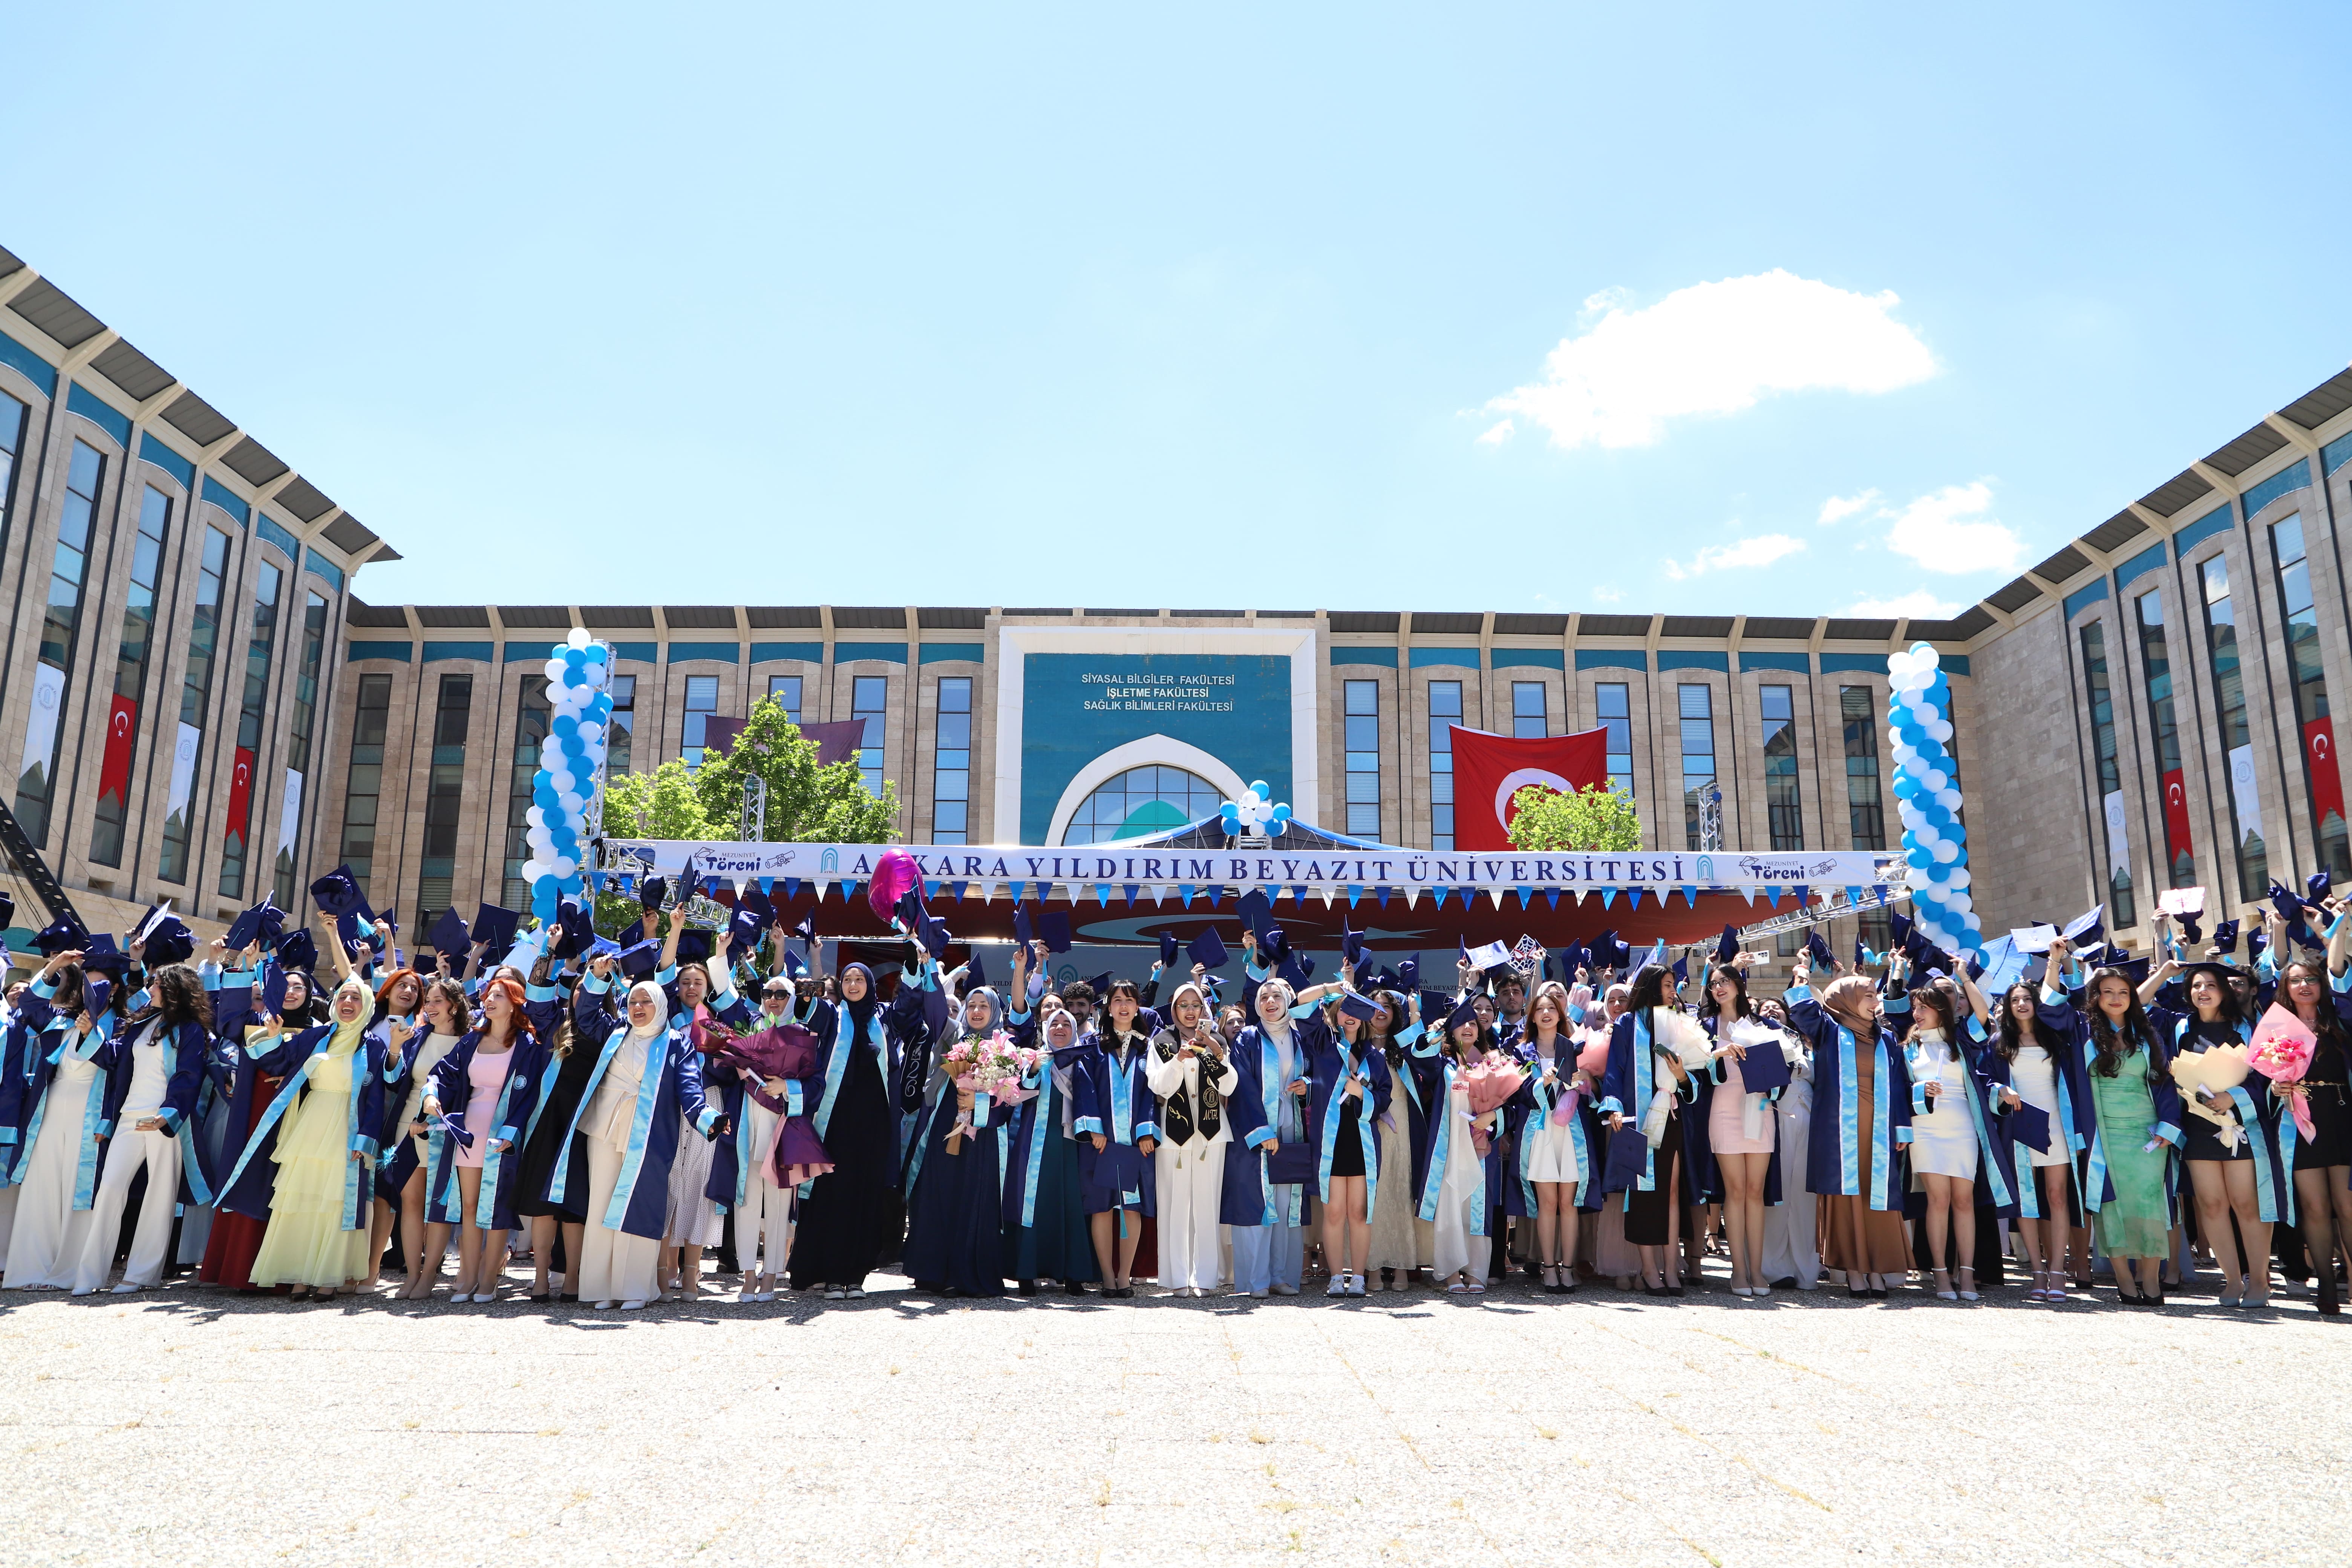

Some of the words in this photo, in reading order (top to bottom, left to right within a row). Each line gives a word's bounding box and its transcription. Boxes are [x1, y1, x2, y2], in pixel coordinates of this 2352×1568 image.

[1081, 673, 1124, 683] SİYASAL
[1127, 674, 1174, 684] BİLGİLER
[1180, 674, 1234, 685] FAKÜLTESİ
[1107, 686, 1151, 699] İŞLETME
[1154, 687, 1208, 697] FAKÜLTESİ
[1084, 699, 1122, 710] SAĞLIK
[1125, 700, 1175, 710] BİLİMLERİ
[1178, 701, 1233, 711] FAKÜLTESİ
[706, 857, 761, 871] Töreni
[851, 854, 1011, 877] AKARA
[1025, 858, 1214, 879] YILDIRIM
[1229, 859, 1392, 880] BEYAZIT
[1407, 856, 1684, 881] ÜNİVERSİTESİ
[1751, 865, 1805, 880] Töreni
[1203, 1109, 1218, 1120] MTA
